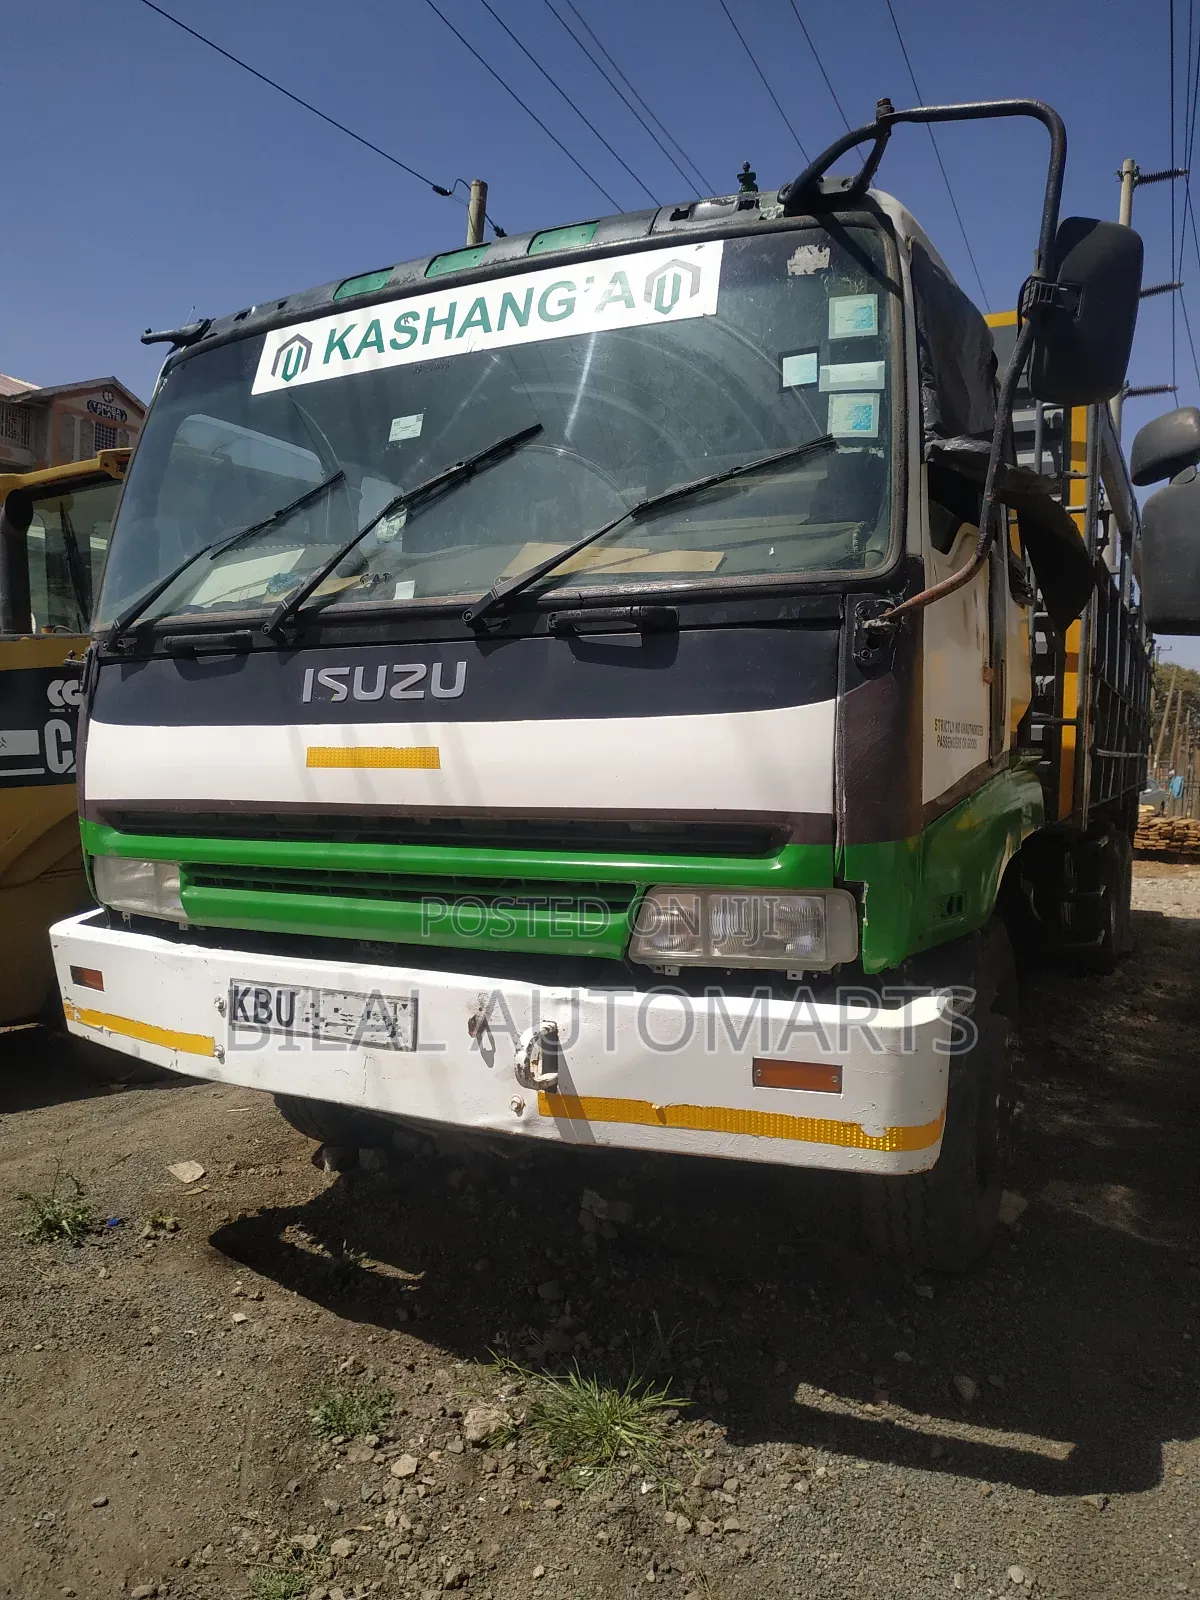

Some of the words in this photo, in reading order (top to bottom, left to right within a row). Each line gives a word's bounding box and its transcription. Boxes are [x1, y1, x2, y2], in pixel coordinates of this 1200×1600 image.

[322, 270, 636, 365] KASHANG'A
[96, 408, 121, 421] FLATS
[302, 661, 467, 703] ISUZU
[934, 718, 954, 733] STRICTLY
[233, 985, 296, 1028] KBU
